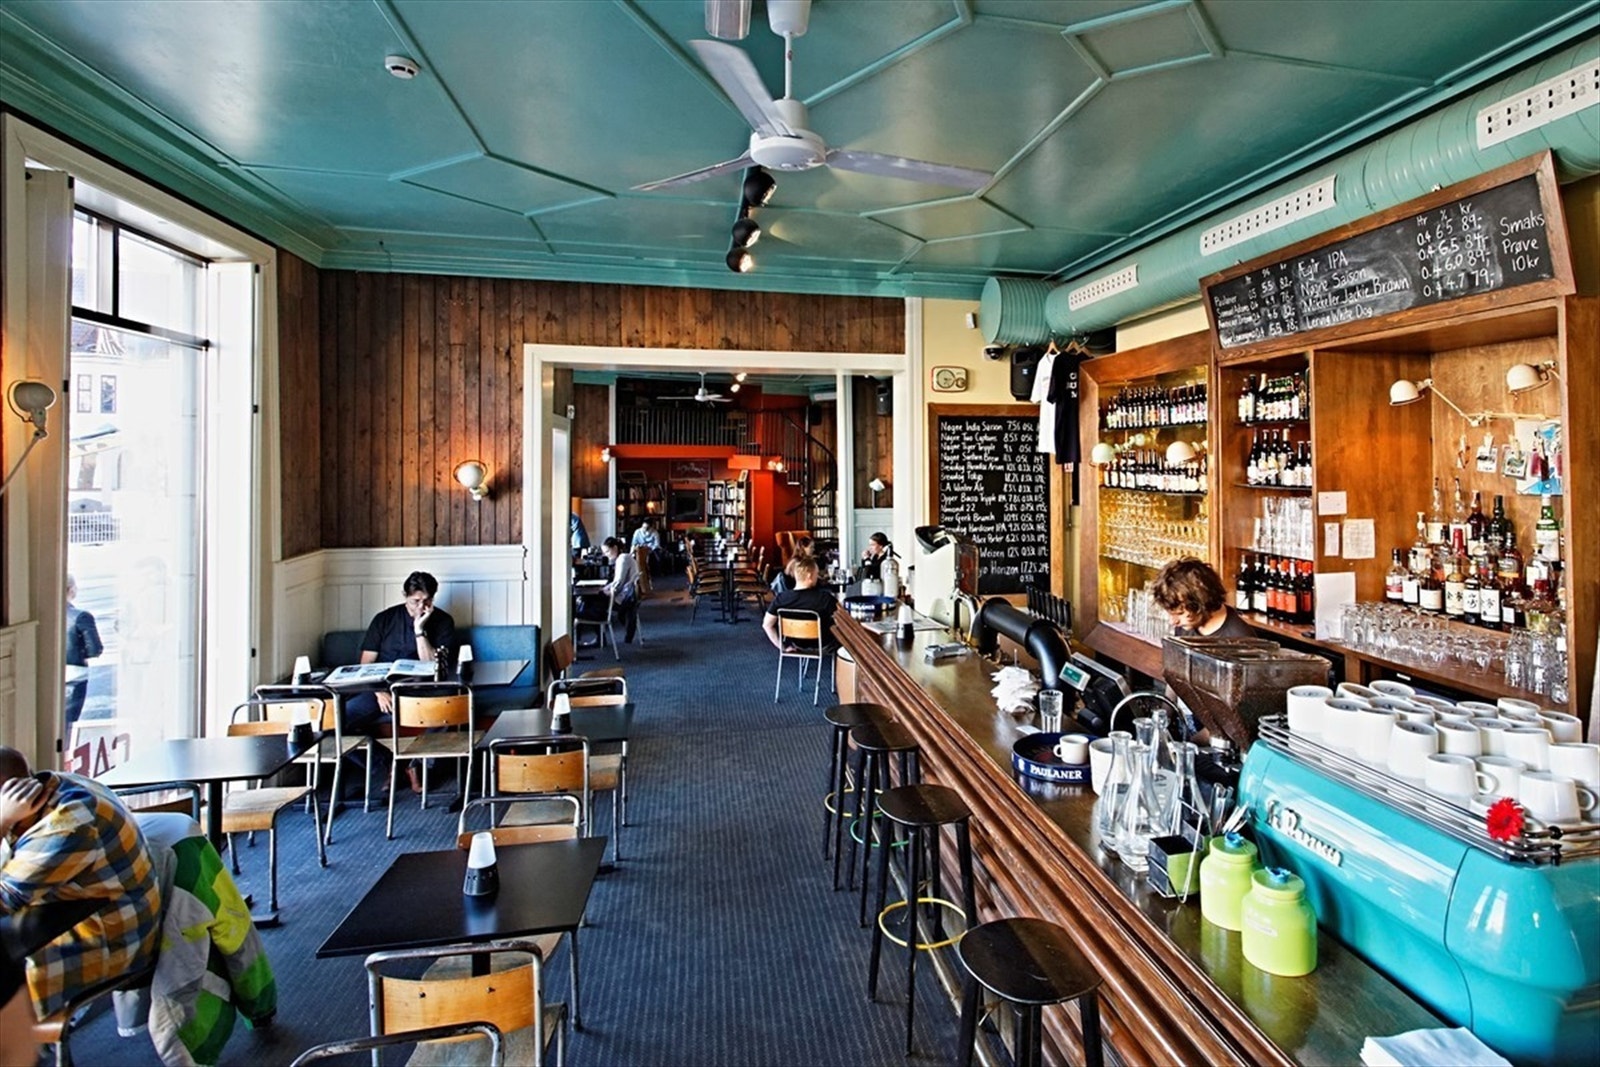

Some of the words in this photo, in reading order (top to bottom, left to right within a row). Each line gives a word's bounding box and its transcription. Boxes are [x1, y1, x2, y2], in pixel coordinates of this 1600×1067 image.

[1459, 202, 1472, 214] kr
[1500, 210, 1545, 236] Smaks
[1502, 238, 1539, 254] Prøve
[1327, 249, 1349, 269] IPA
[1332, 268, 1367, 289] Saison
[1340, 284, 1369, 304] Jackie
[1372, 275, 1409, 296] Brown
[1355, 303, 1373, 319] Dog
[980, 547, 1005, 559] Weizen
[990, 560, 1019, 575] Horizon
[1030, 765, 1083, 780] PAULANER
